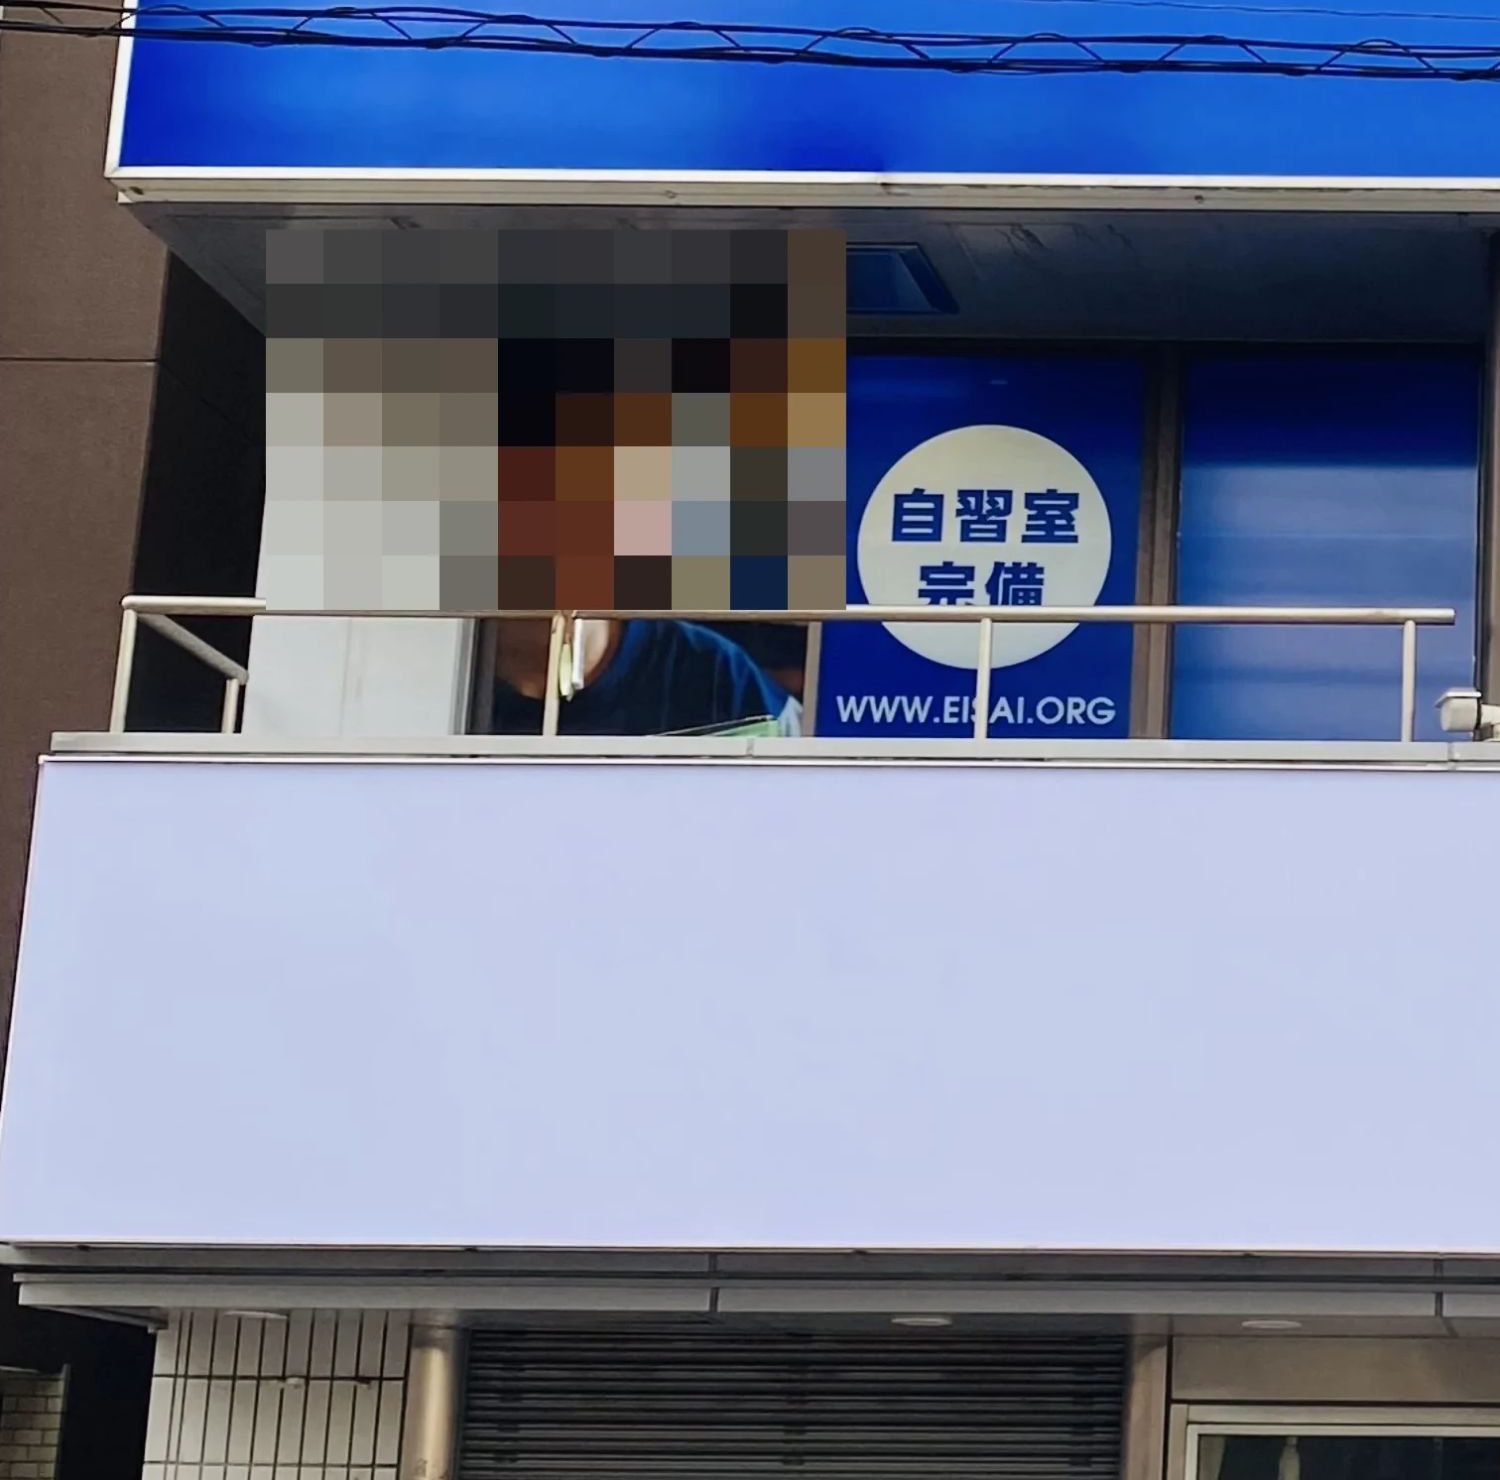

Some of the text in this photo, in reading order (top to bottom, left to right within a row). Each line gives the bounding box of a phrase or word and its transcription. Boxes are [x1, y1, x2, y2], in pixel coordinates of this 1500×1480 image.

[891, 487, 1080, 544] 自習室
[917, 560, 1046, 606] 完備
